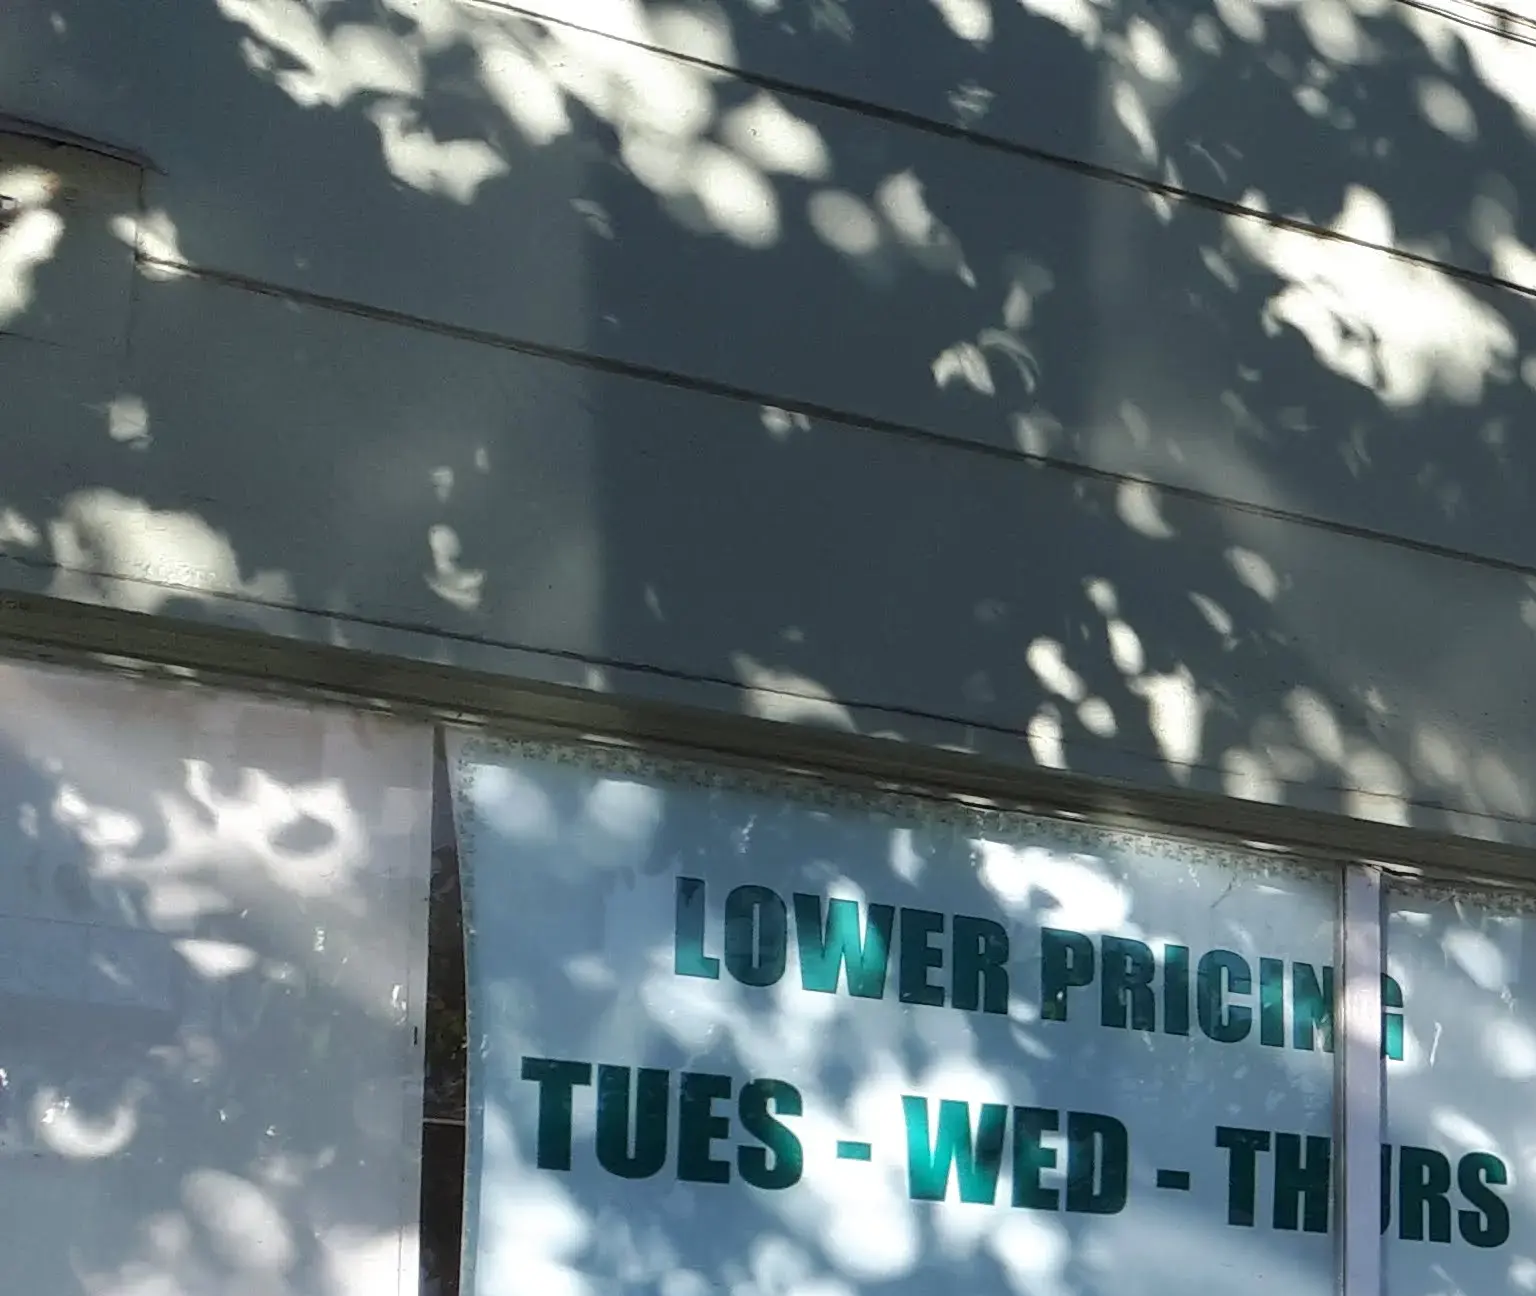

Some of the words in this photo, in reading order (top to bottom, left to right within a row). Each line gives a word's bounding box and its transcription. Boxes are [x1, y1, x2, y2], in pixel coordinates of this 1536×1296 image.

[674, 875, 1010, 1016] LOWER
[520, 1056, 804, 1191] TUES
[836, 1141, 872, 1161] -
[901, 1095, 1129, 1216] WED
[1156, 1169, 1191, 1191] -
[1214, 1125, 1511, 1249] THRS
